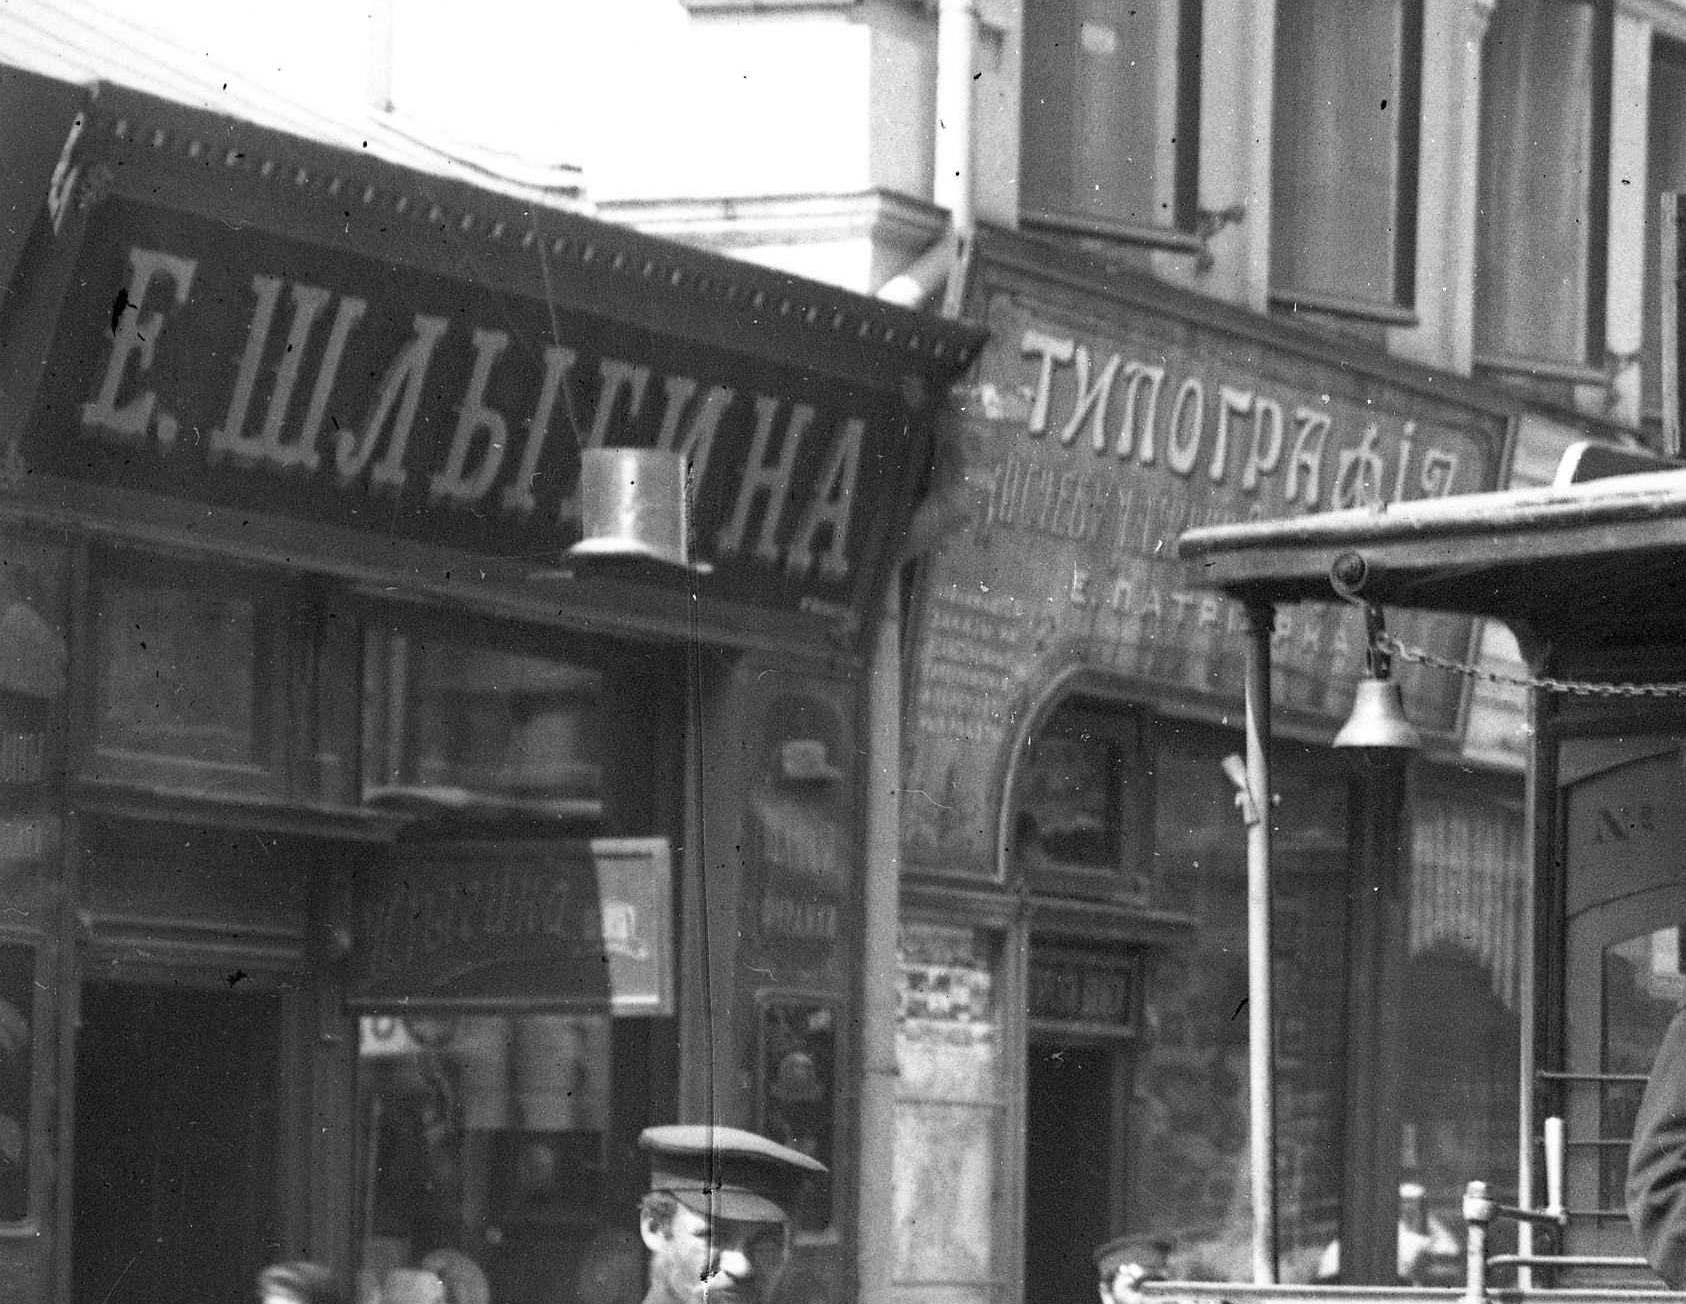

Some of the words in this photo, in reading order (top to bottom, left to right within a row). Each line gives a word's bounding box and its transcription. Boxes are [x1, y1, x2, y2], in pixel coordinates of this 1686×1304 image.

[81, 246, 198, 444] Е.
[211, 272, 866, 582] ШЛЫГИНА
[1020, 329, 1460, 513] ТИПОГРАФІЯ
